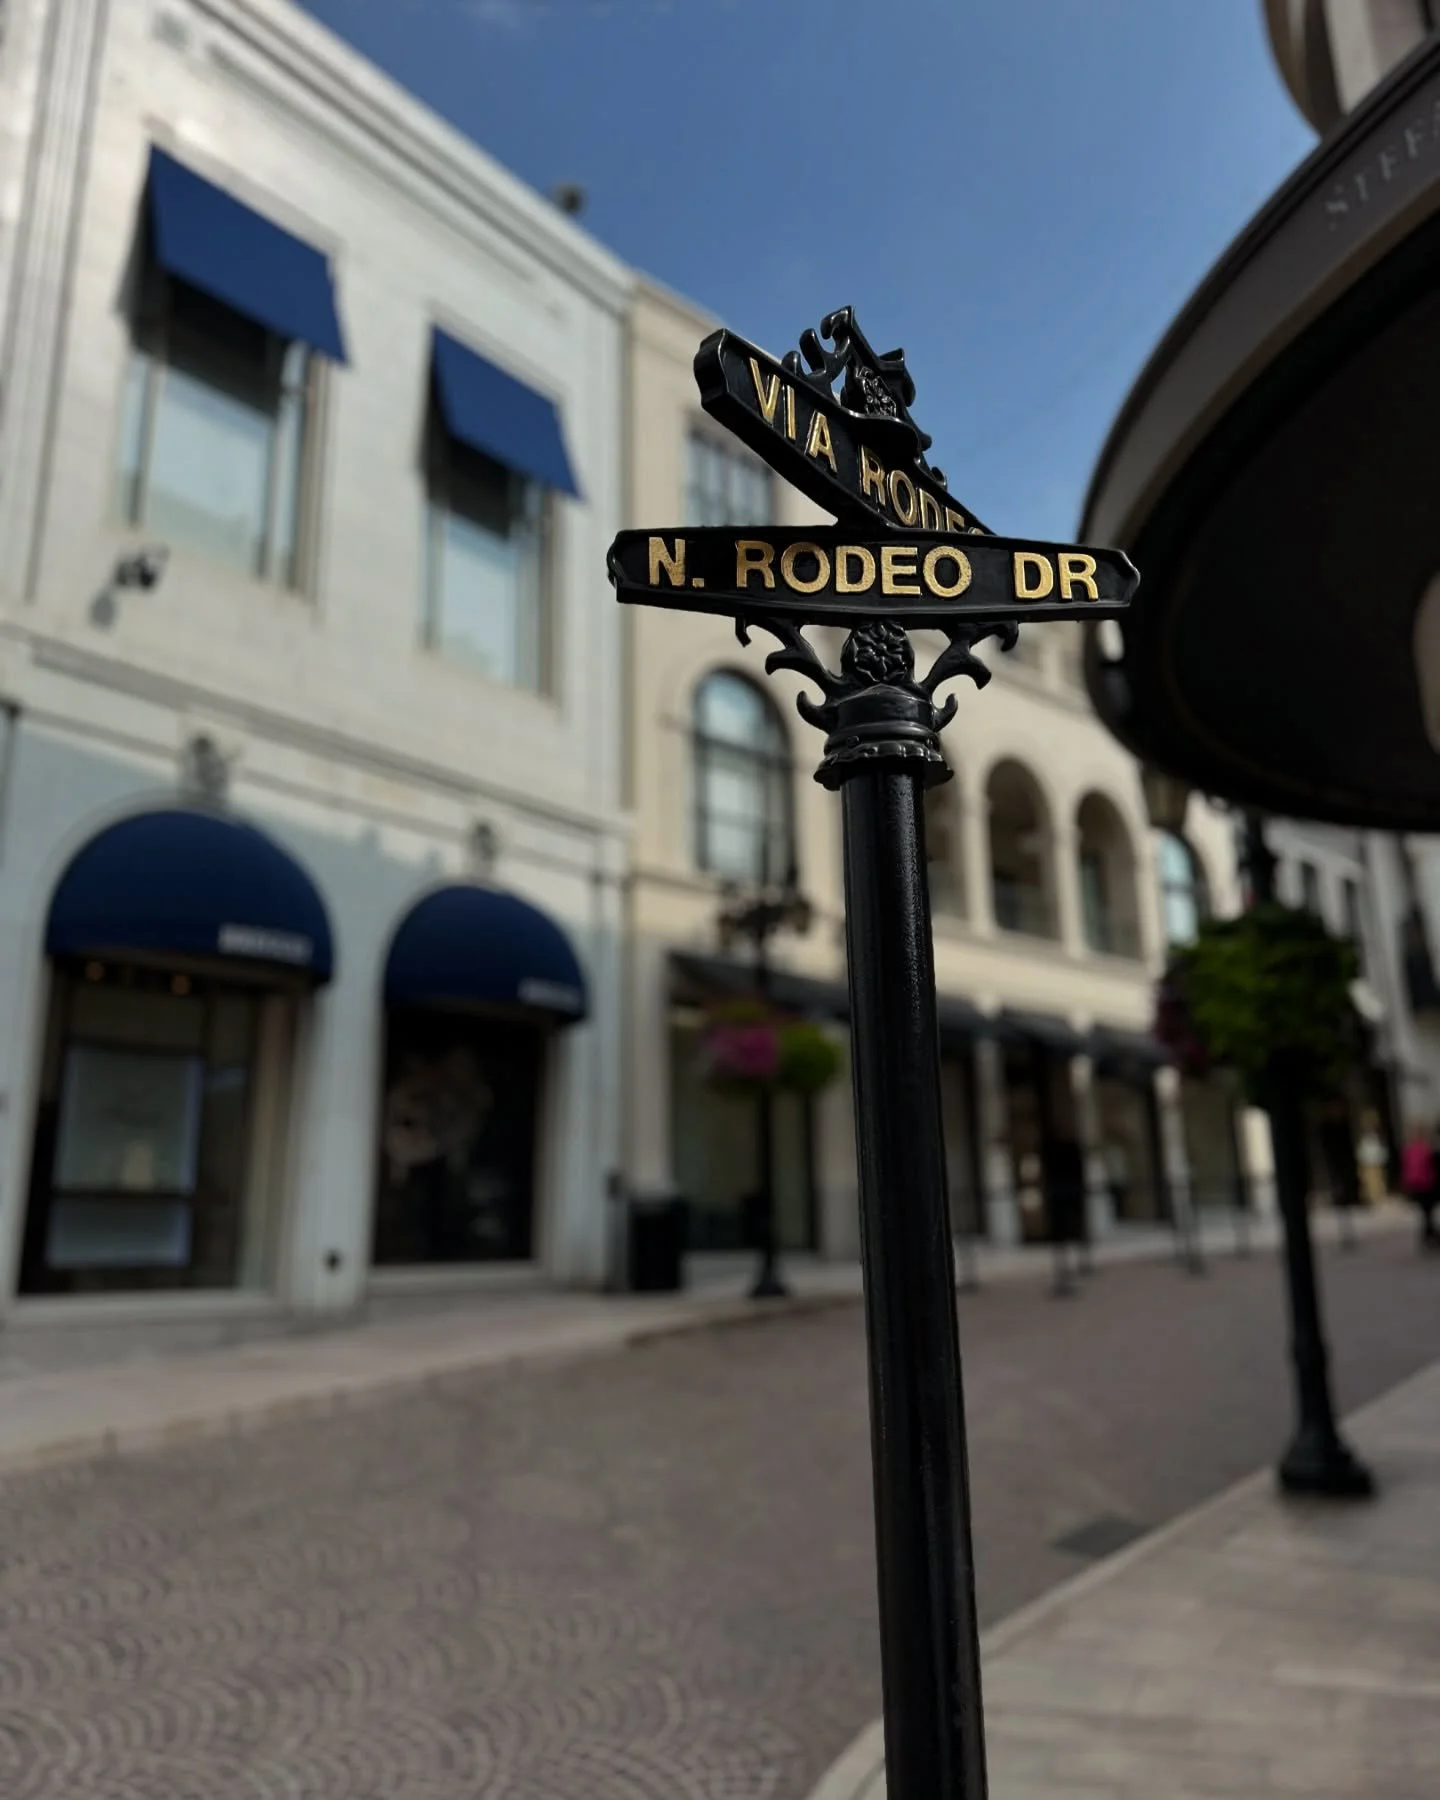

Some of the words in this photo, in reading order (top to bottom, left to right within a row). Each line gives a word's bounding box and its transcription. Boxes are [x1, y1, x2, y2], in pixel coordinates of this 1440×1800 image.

[748, 357, 837, 472] VIA
[859, 444, 985, 535] RODE
[648, 536, 705, 588] N.
[735, 540, 973, 599] RODEO
[1012, 551, 1100, 601] DR
